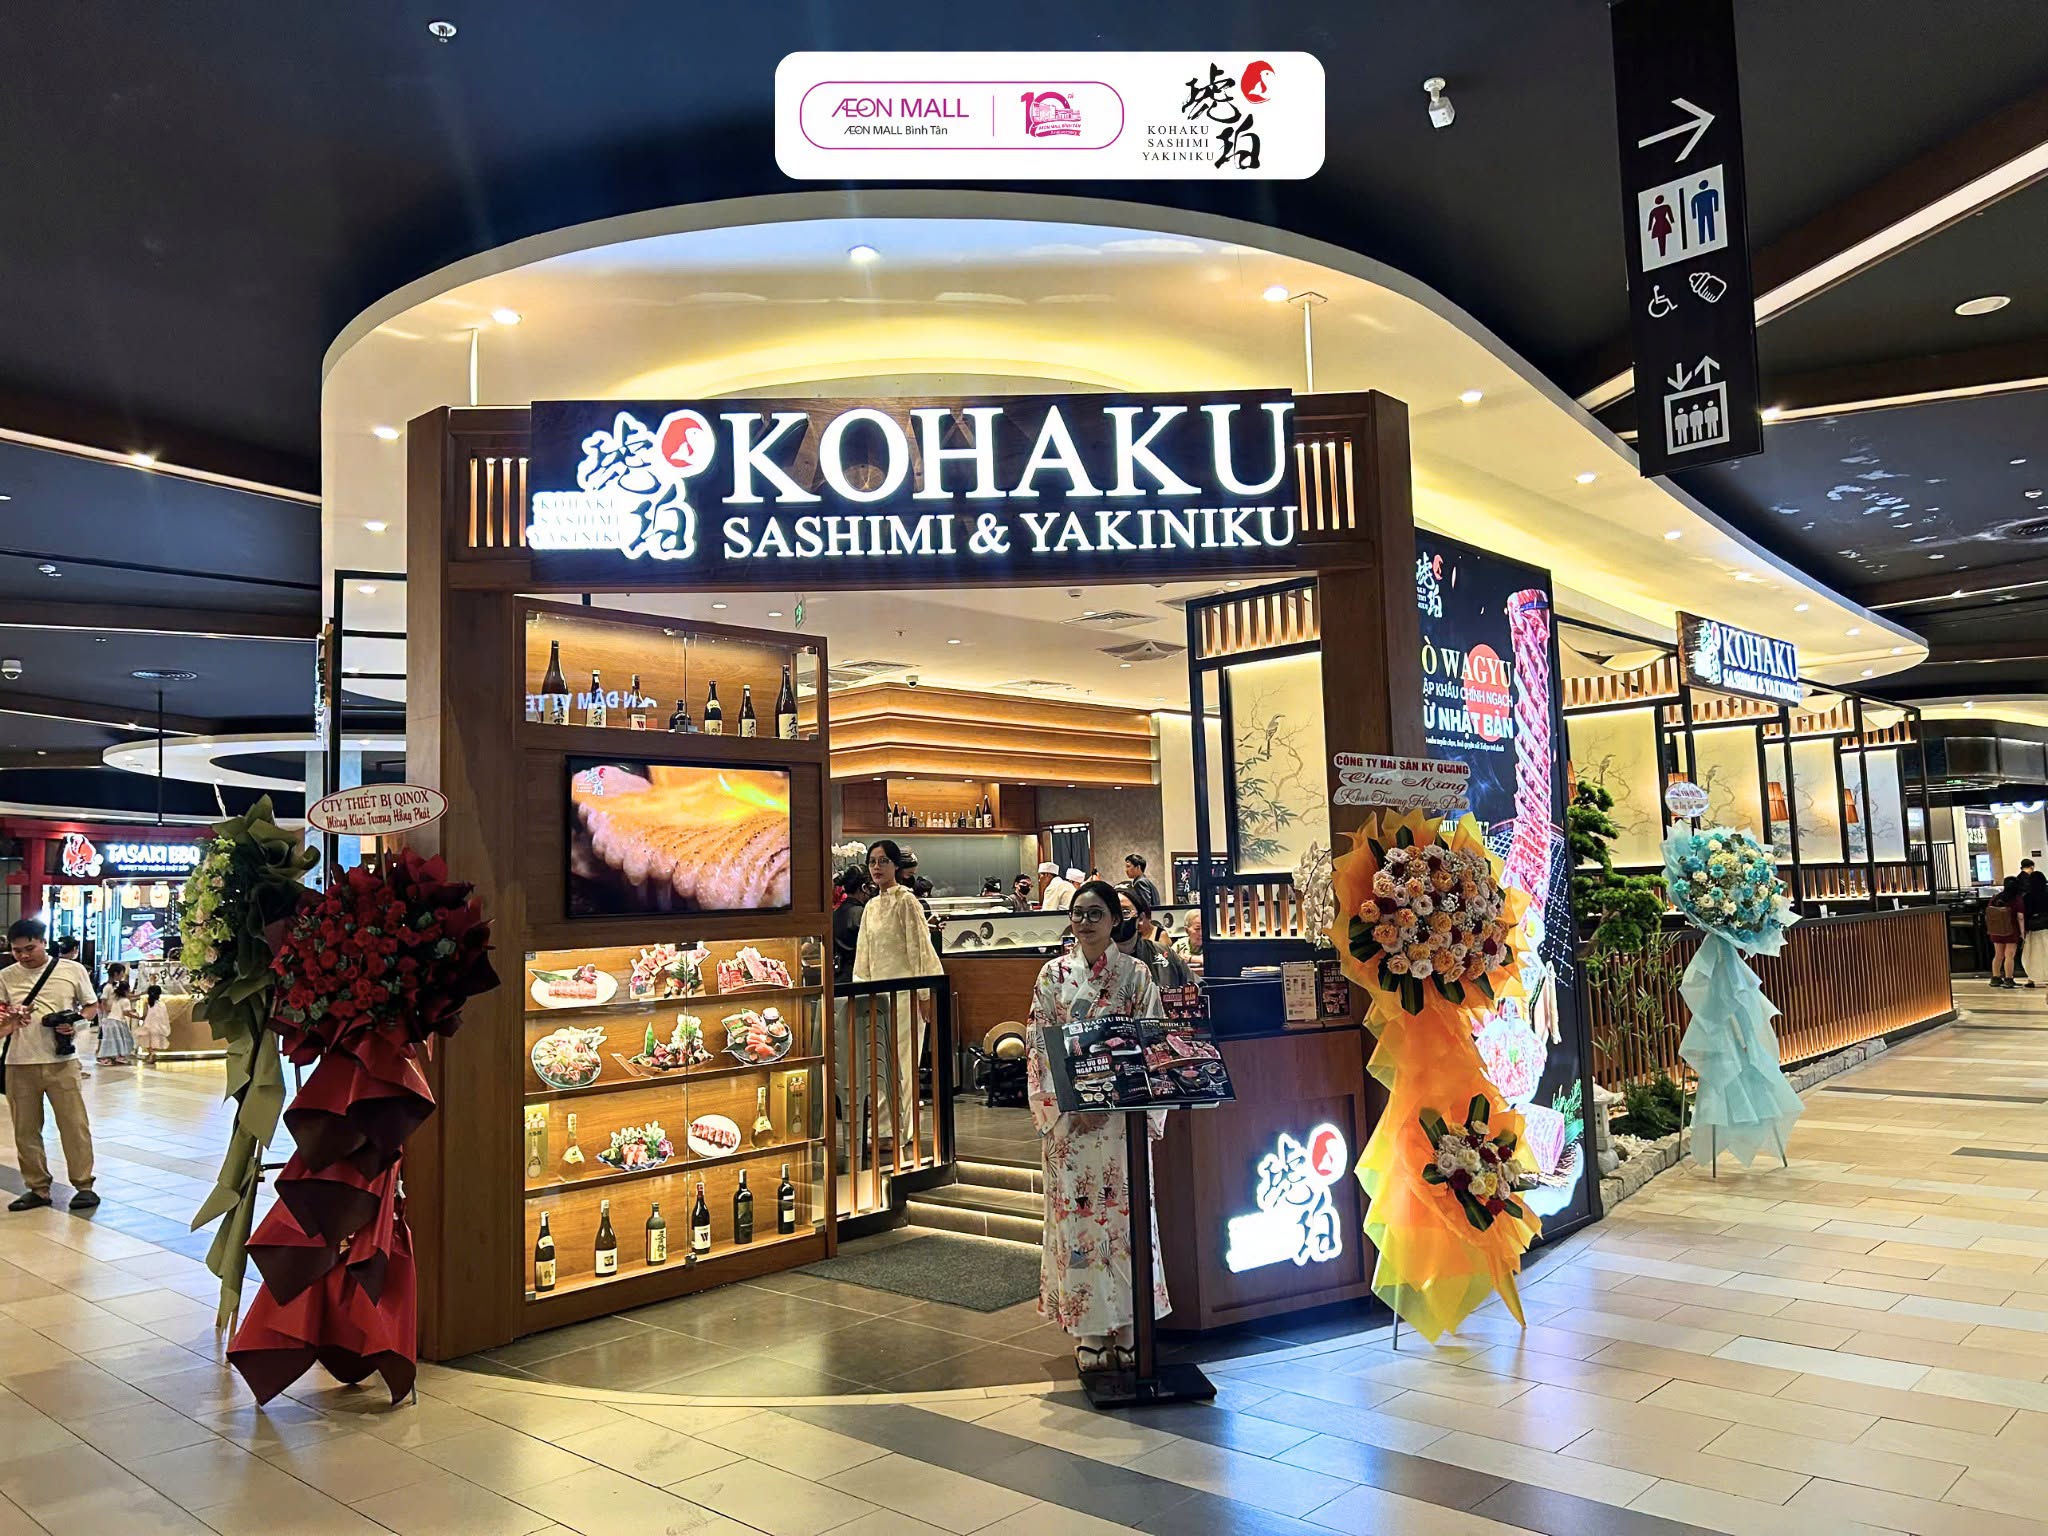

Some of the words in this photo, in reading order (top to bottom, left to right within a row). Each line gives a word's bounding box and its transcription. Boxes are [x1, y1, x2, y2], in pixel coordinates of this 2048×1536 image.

[719, 402, 1295, 505] KOHAKU
[722, 512, 957, 560] SASHIMI
[967, 512, 1011, 556] &
[1011, 505, 1299, 553] YAKINIKU
[1421, 635, 1438, 675] Ò
[1440, 648, 1512, 688] WAGYU
[1720, 625, 1799, 682] KOHAKU
[1423, 677, 1435, 697] ẬP
[1423, 698, 1436, 730] Ừ
[1335, 755, 1363, 767] CÔNG
[1366, 757, 1377, 768] TY
[1436, 763, 1469, 775] QUANG
[321, 798, 342, 813] CTY
[345, 790, 377, 810] THIẾT
[380, 794, 391, 809] BỊ
[394, 790, 430, 806] QINOX
[106, 844, 168, 865] TASAKI
[168, 845, 201, 866] BBQ
